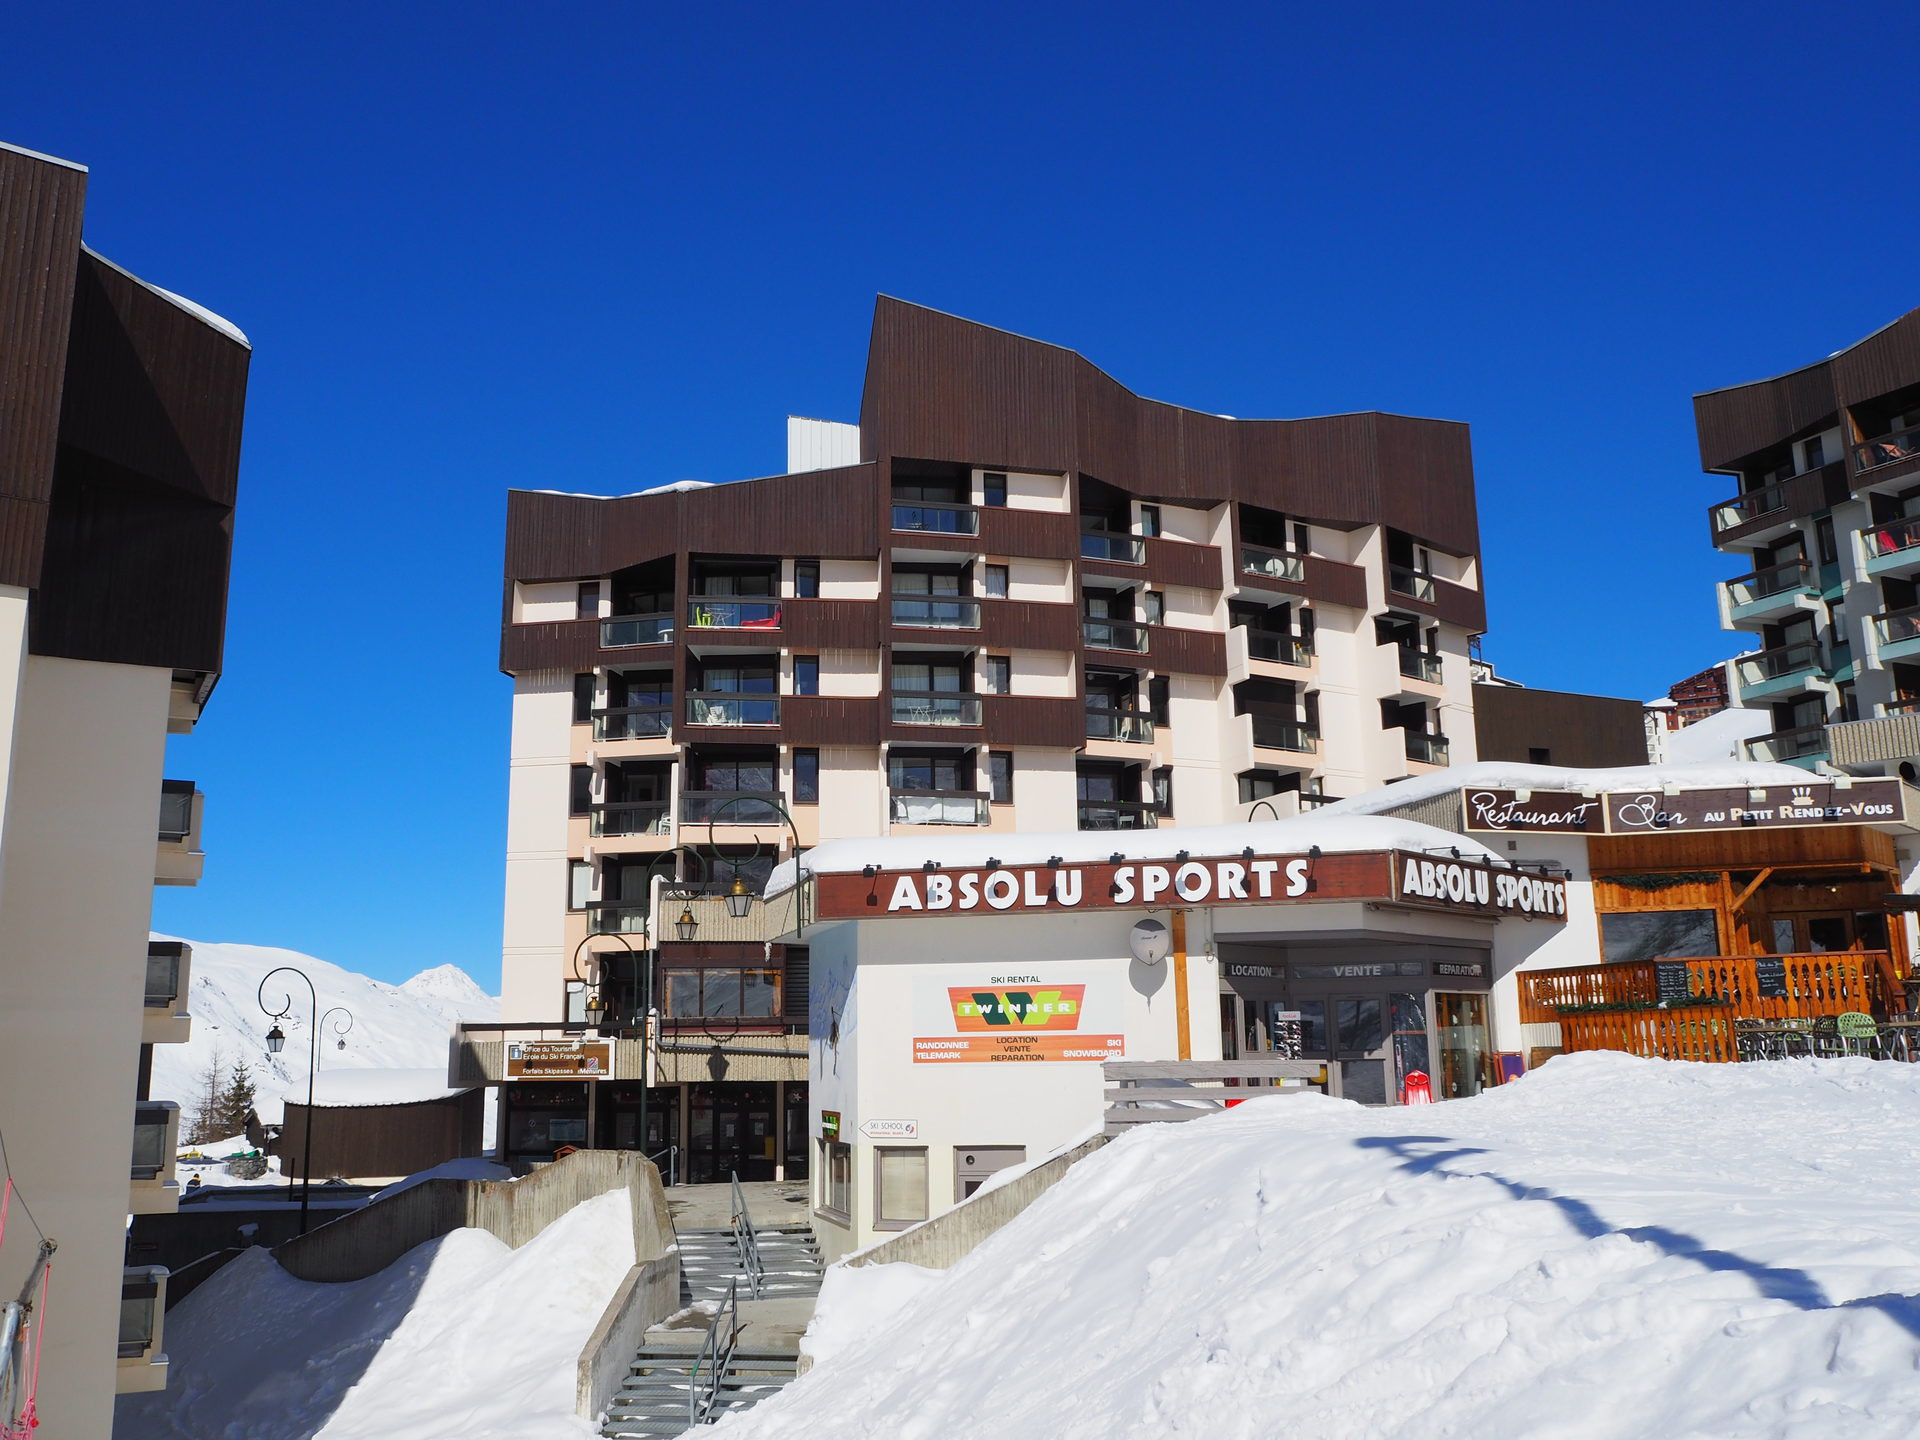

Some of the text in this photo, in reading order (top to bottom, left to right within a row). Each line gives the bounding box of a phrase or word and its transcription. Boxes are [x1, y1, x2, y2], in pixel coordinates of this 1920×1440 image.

[1471, 791, 1599, 830] Restaurant
[1618, 794, 1688, 830] Bar
[1703, 811, 1726, 822] AU
[887, 859, 1308, 912] ABSOLU SPORTS
[1403, 858, 1565, 915] ABSOLU SPORTS
[1231, 964, 1272, 977] LOCATION
[1333, 965, 1382, 977] VENTE
[1439, 964, 1482, 976] REPARATION
[991, 976, 1041, 984] SKI RENTAL
[962, 1002, 1071, 1014] TWINNER
[996, 1036, 1038, 1044] LOCATION
[1107, 1039, 1122, 1047] SKI
[541, 1045, 550, 1053] du
[915, 1041, 969, 1049] RANDONNEE
[1003, 1045, 1031, 1053] VENTE
[915, 1052, 961, 1060] TELEMARK
[1063, 1049, 1122, 1057] SNOWBOARD
[990, 1054, 1045, 1062] REPARATION
[870, 1122, 904, 1130] SKI SCHOOL
